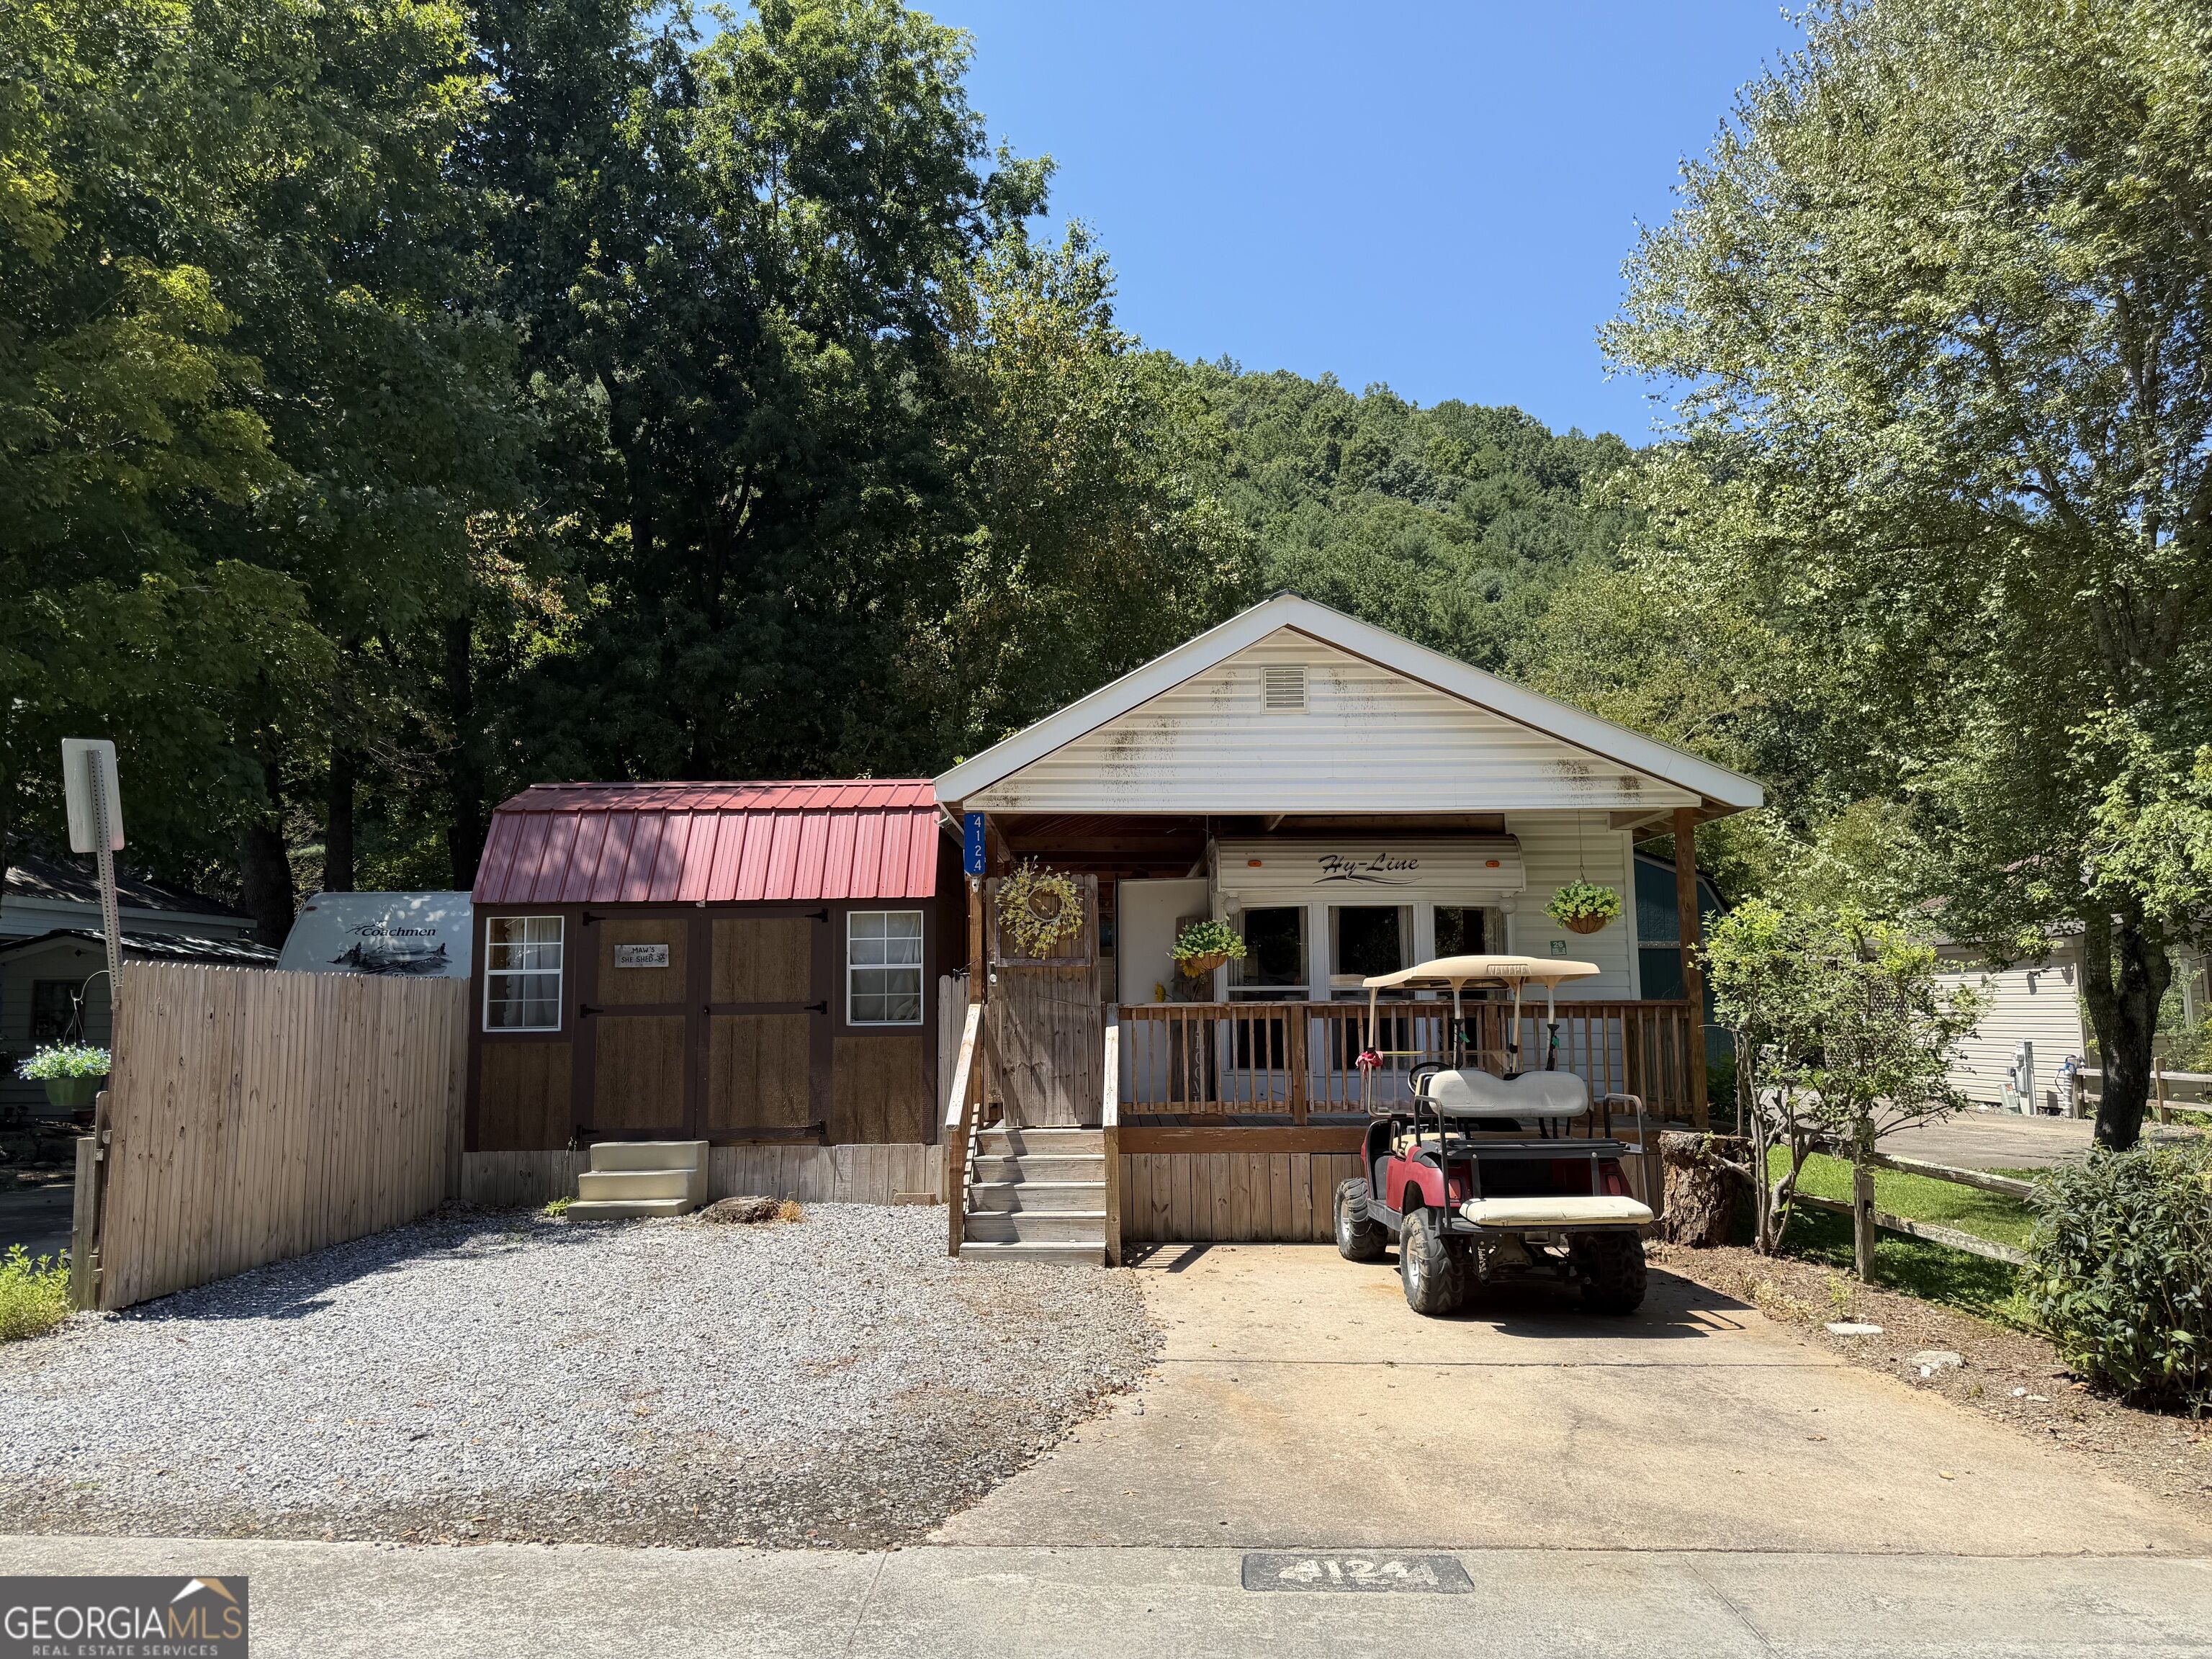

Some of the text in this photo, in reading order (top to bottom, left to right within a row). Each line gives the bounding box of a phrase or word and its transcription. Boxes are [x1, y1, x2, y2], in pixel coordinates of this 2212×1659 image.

[1318, 852, 1419, 878] Hy-Line
[361, 927, 436, 937] Coachmen
[1278, 1559, 1439, 1585] 4124
